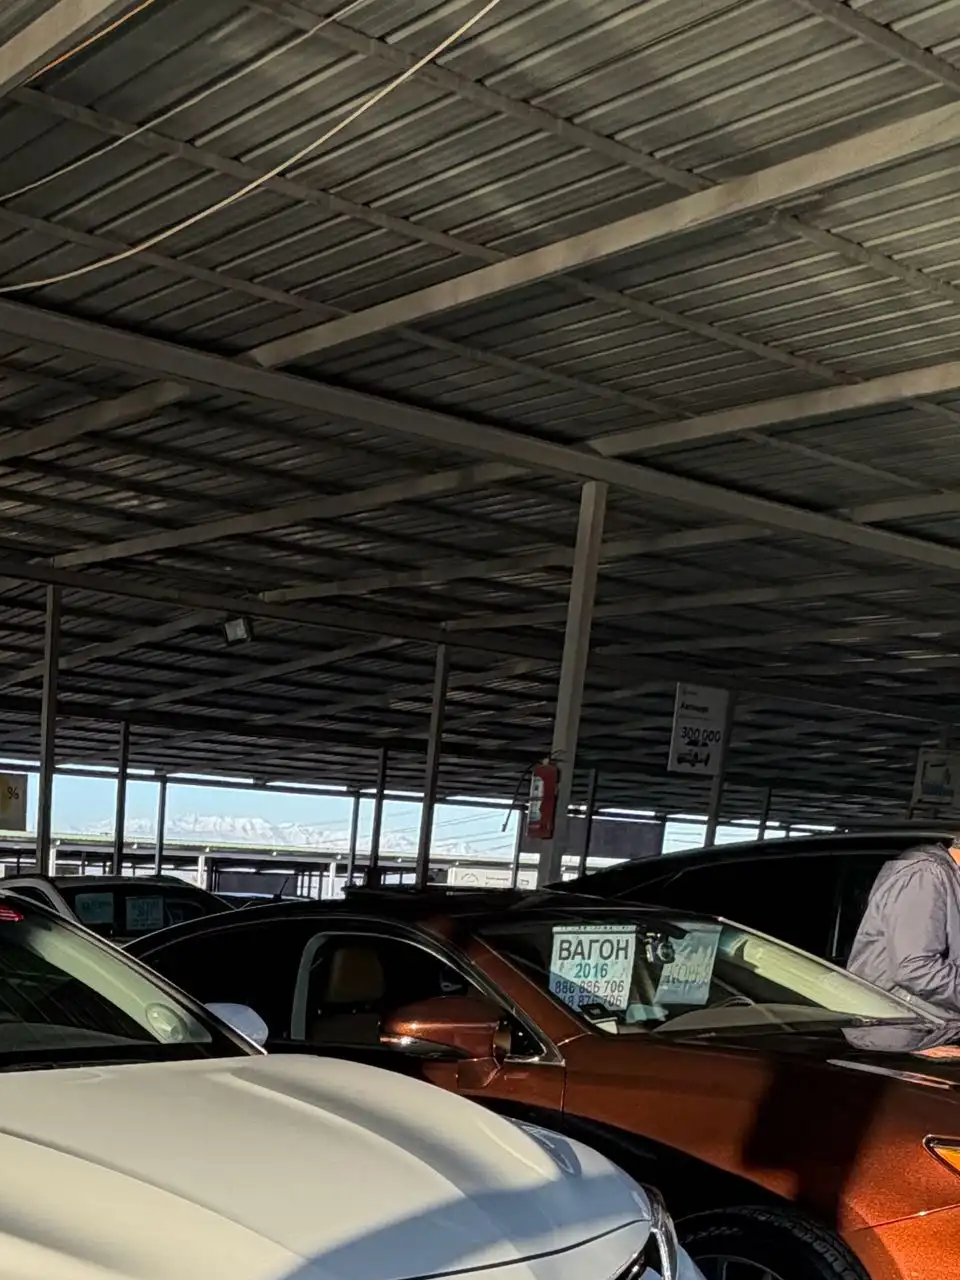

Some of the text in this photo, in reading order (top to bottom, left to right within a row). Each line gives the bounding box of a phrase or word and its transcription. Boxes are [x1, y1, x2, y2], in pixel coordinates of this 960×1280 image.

[558, 939, 630, 961] ВАГОН
[574, 963, 609, 979] 2016
[603, 980, 625, 993] 706
